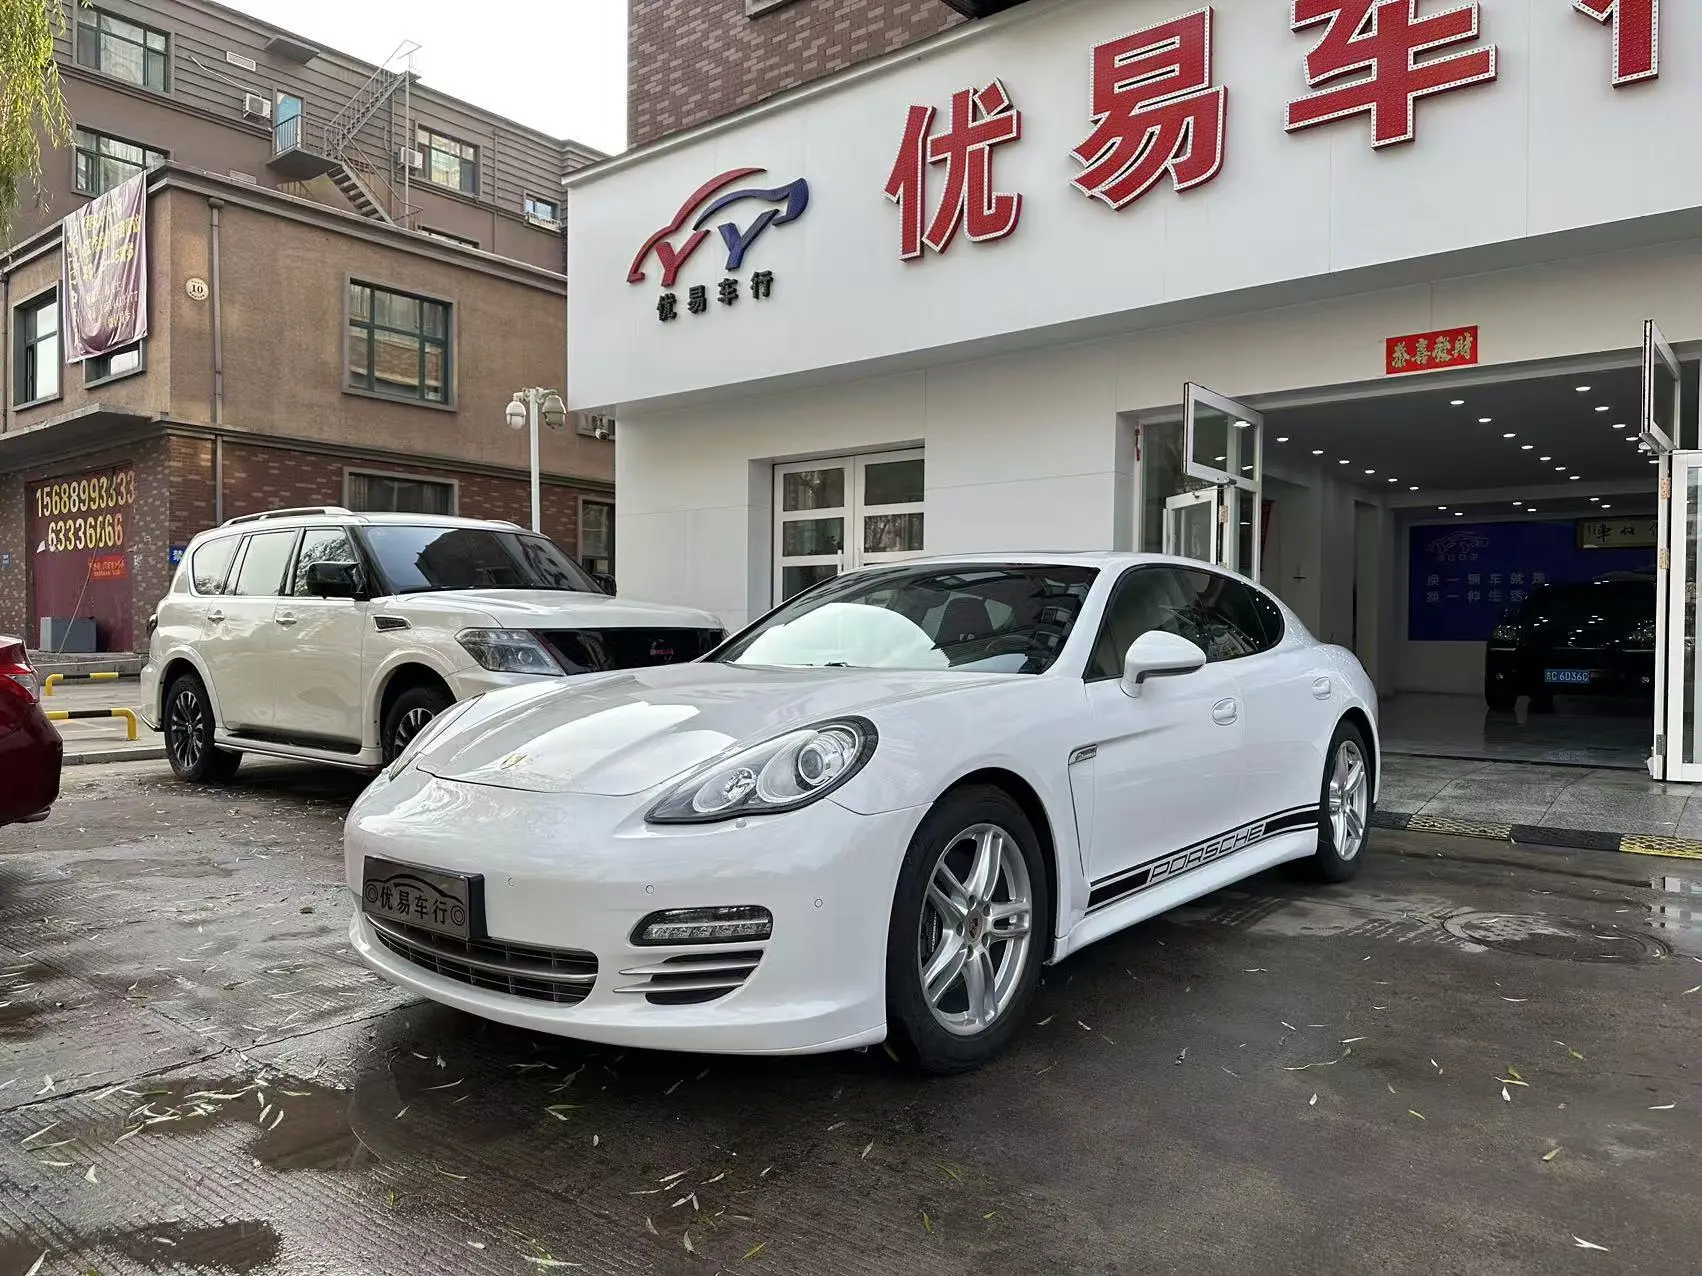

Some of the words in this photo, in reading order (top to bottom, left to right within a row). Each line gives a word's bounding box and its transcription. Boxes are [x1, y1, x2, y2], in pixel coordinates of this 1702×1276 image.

[191, 284, 204, 294] 10
[656, 270, 774, 322] 优易车行
[48, 513, 124, 552] 63336666
[1149, 822, 1266, 882] PORSCHE
[379, 885, 448, 925] 优易车行
